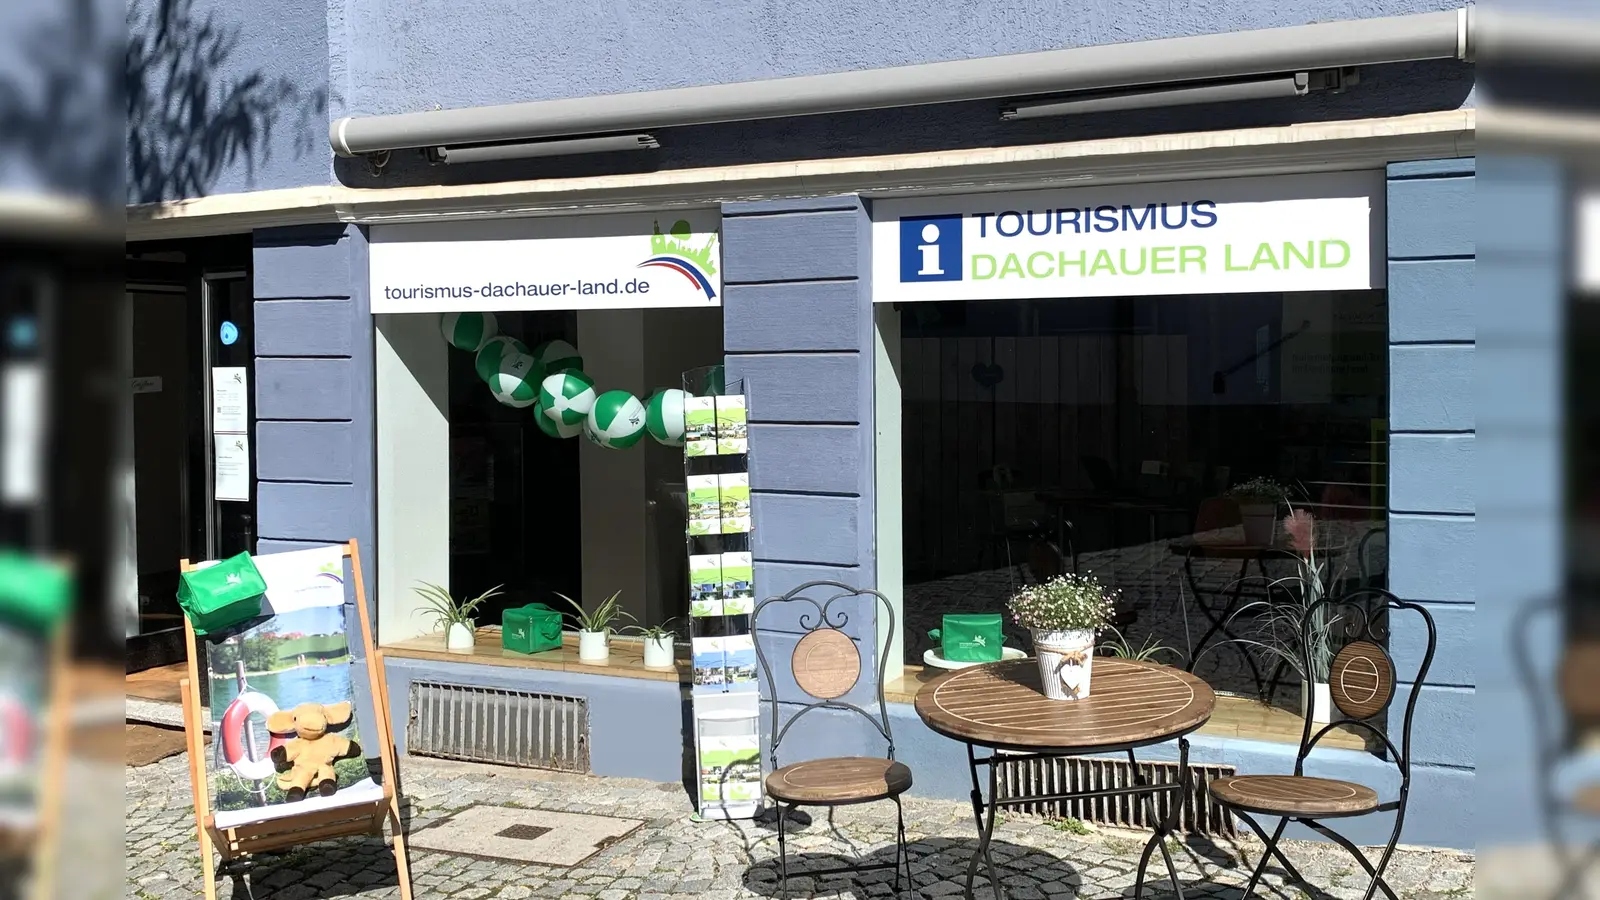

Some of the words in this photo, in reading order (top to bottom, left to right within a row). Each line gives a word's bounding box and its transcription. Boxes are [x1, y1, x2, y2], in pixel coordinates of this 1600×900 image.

[971, 200, 1218, 238] TOURISMUS
[970, 245, 1207, 280] DACHAUER
[1224, 239, 1352, 272] LAND
[384, 278, 650, 300] tourismus-dachauer-land.de
